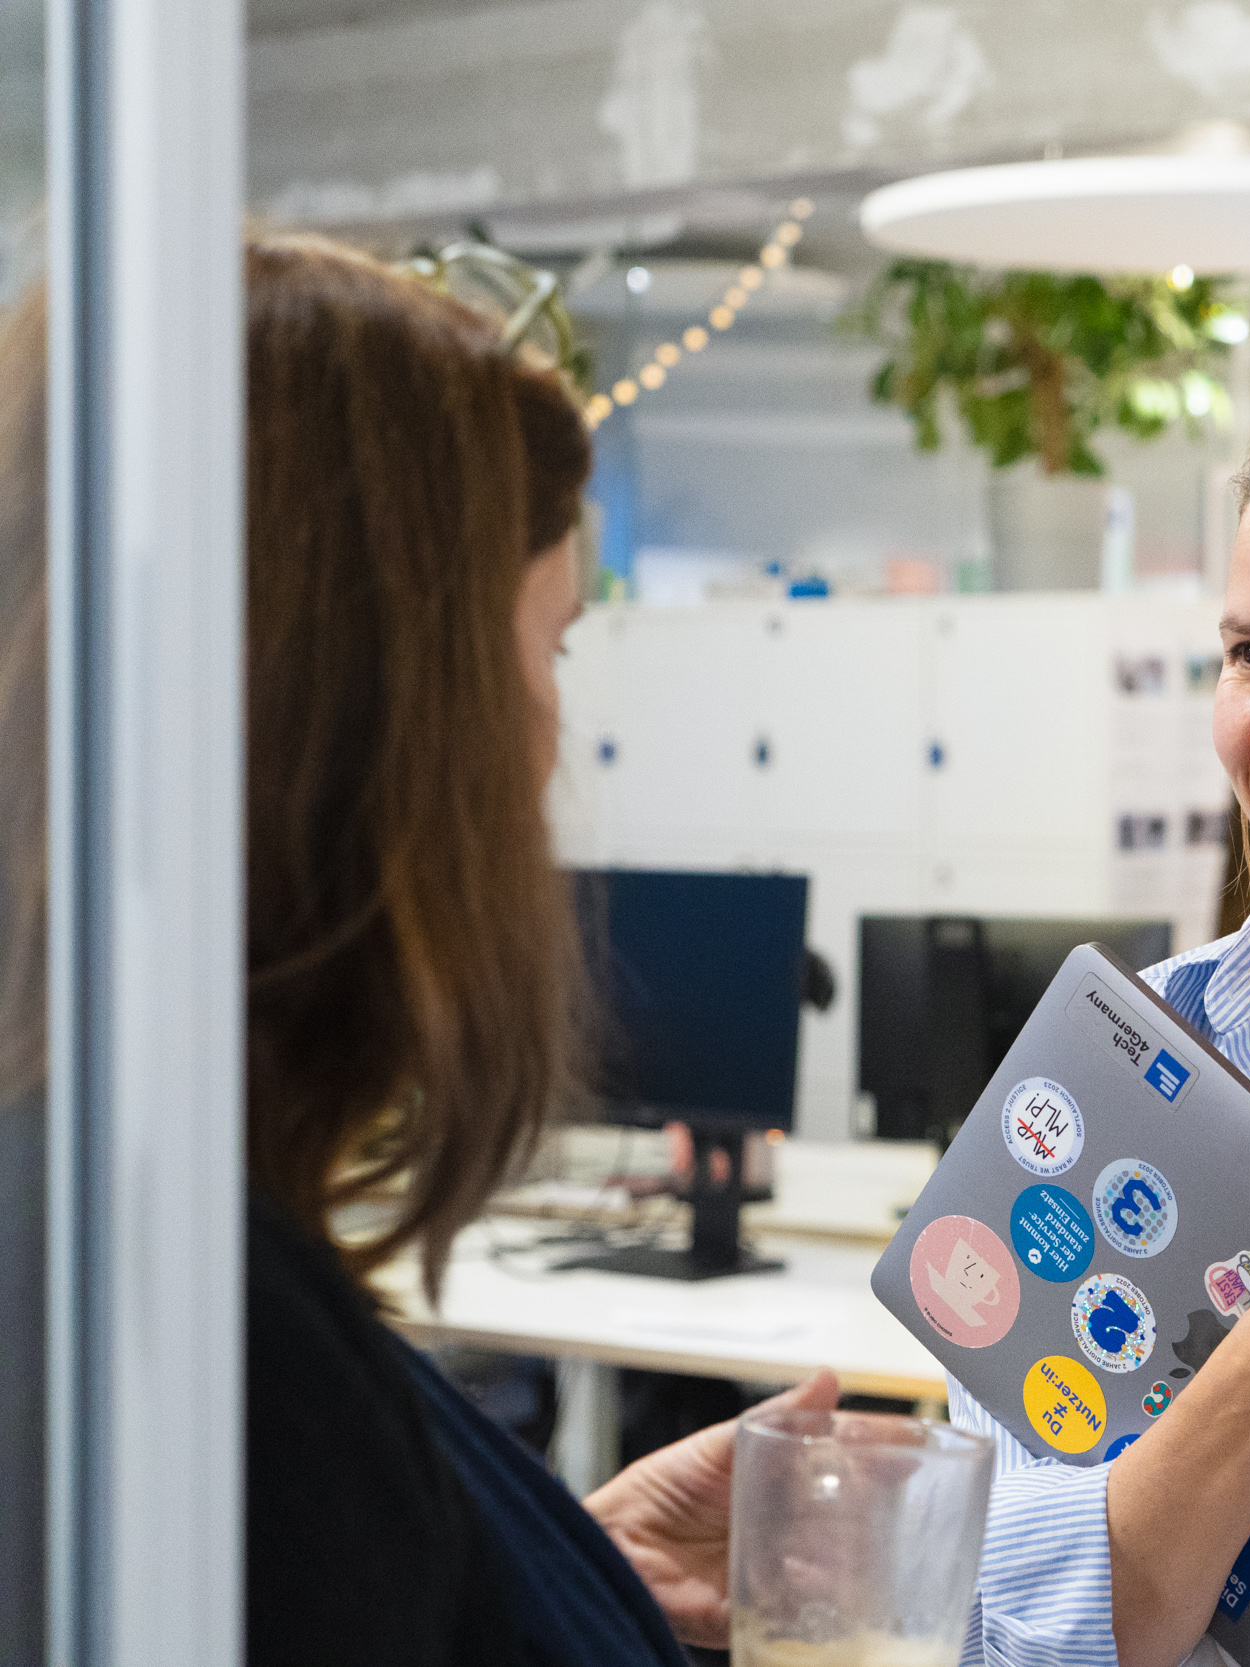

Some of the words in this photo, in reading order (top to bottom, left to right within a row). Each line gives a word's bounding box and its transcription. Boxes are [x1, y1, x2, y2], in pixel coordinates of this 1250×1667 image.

[1085, 990, 1150, 1053] 4Germany
[1112, 1032, 1141, 1067] Tech
[1007, 1084, 1027, 1107] JUSTICE
[1043, 1081, 1060, 1093] 2023
[1025, 1092, 1069, 1138] MLP!
[1060, 1091, 1082, 1137] SOFTLAUNCH
[1004, 1114, 1013, 1144] ACCESS
[1018, 1155, 1037, 1172] TRUST
[1051, 1164, 1067, 1174] RAST
[1066, 1156, 1074, 1165] IN
[1138, 1163, 1154, 1175] 2023
[1153, 1171, 1173, 1201] OKTOBER
[1039, 1189, 1071, 1225] Einsatz
[1019, 1216, 1051, 1253] kommt
[1028, 1211, 1061, 1248] Service-
[1044, 1212, 1083, 1252] standard
[1070, 1220, 1090, 1243] zum
[1095, 1197, 1122, 1248] DIGITALSERVICE
[1049, 1249, 1070, 1272] Hier
[1060, 1245, 1076, 1262] der
[1123, 1245, 1142, 1255] JAHRE
[1115, 1277, 1131, 1289] 2022
[1215, 1279, 1237, 1307] ERST
[1223, 1269, 1246, 1298] WACH
[1130, 1286, 1151, 1315] OKTOBER
[1101, 1360, 1121, 1370] JAHRE
[1040, 1362, 1102, 1432] Nutzer:in
[1042, 1410, 1063, 1436] Du
